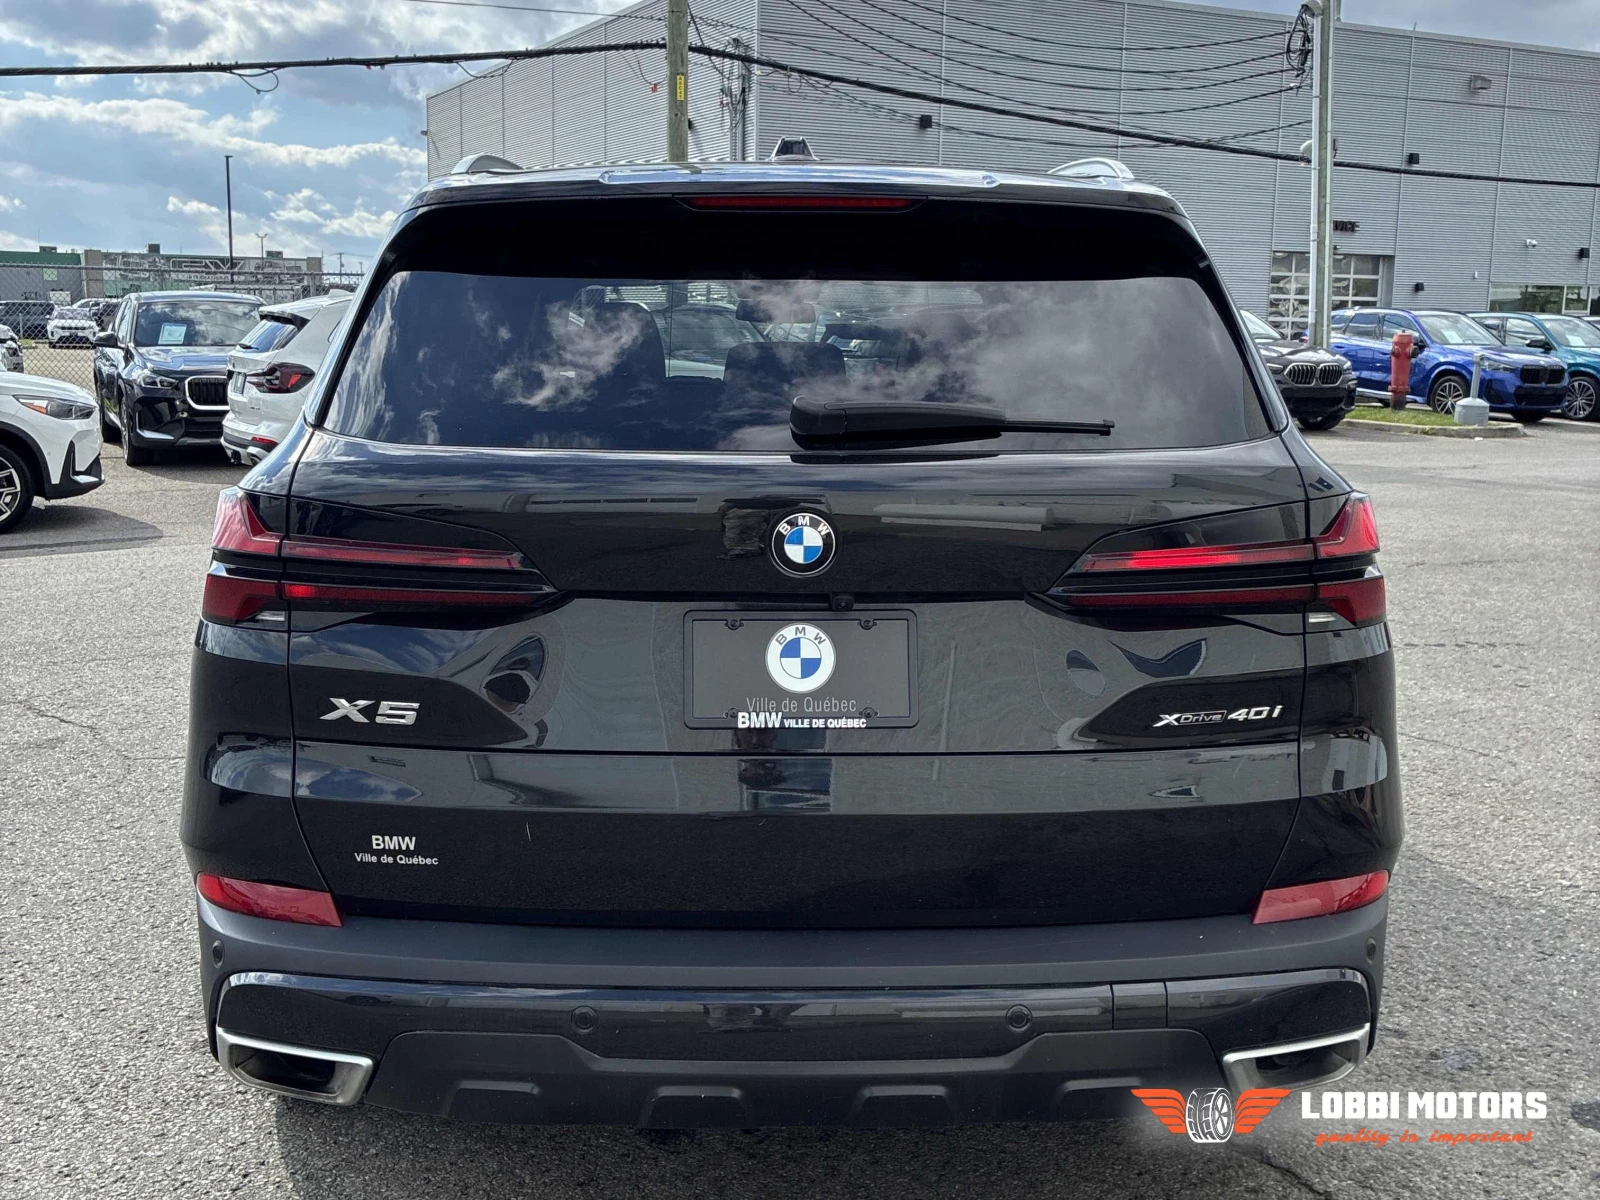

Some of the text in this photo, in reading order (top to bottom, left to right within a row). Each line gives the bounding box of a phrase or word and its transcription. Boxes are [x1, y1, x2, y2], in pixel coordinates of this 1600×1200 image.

[779, 516, 829, 536] BMW
[775, 627, 827, 646] BMW
[319, 698, 420, 725] X5
[746, 696, 857, 713] Ville de Québec
[737, 712, 867, 729] BMW VILLE DE QUÉBEC
[371, 835, 416, 851] BMW
[354, 852, 439, 865] Ville de Québec
